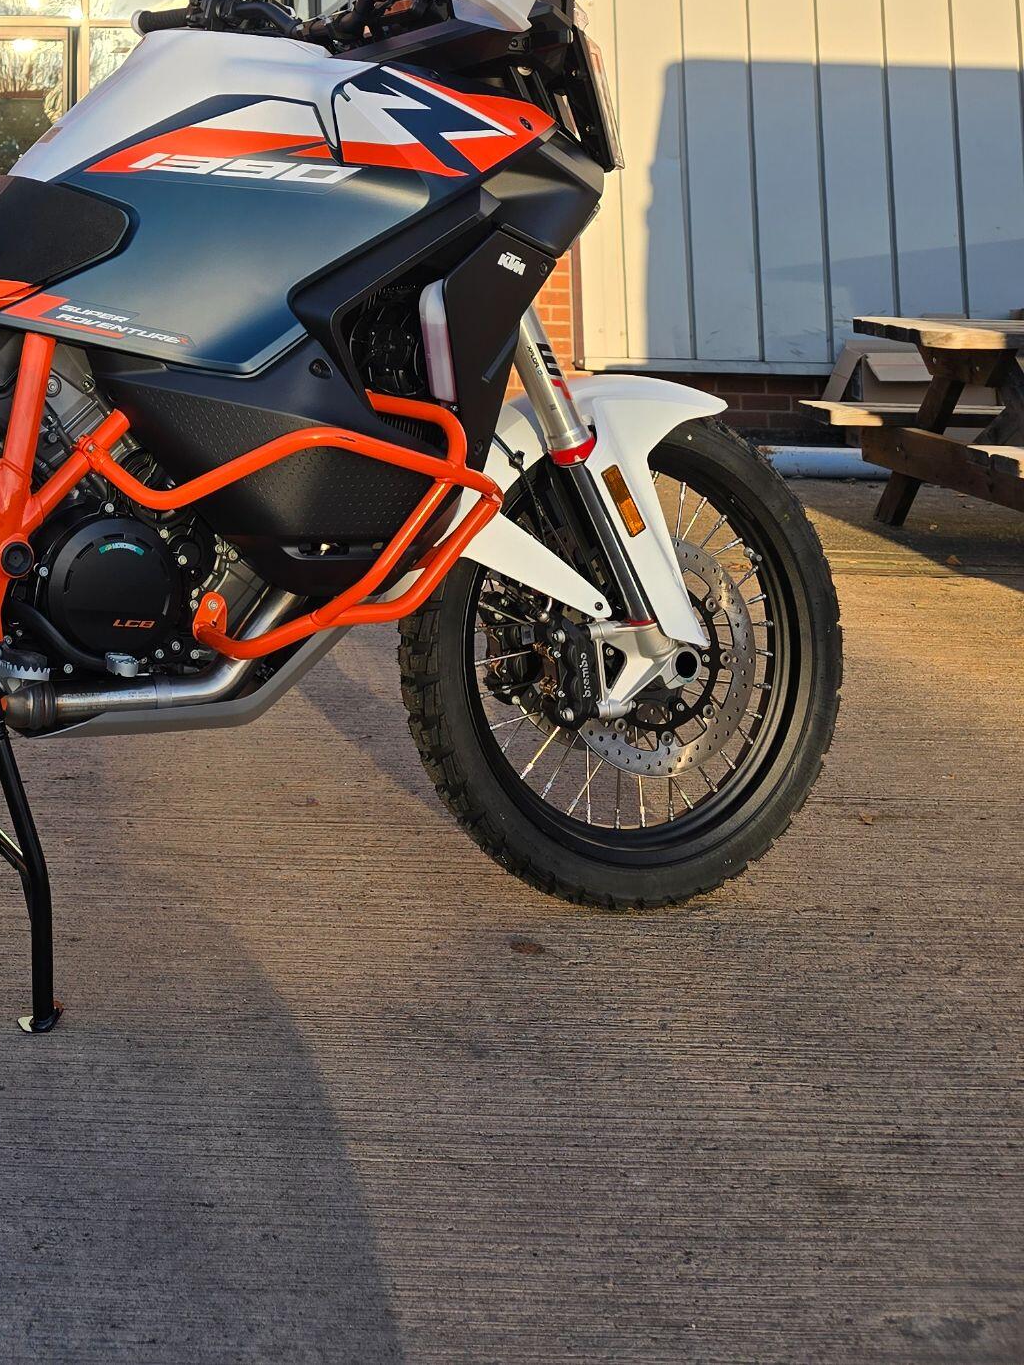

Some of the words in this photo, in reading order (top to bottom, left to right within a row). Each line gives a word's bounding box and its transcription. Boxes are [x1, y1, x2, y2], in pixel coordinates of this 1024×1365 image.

[128, 152, 363, 184] 1390
[497, 251, 526, 276] KTM
[59, 304, 131, 324] SUPER
[55, 313, 180, 344] ADVENTURE
[113, 619, 156, 629] LC8
[579, 652, 592, 698] brembo
